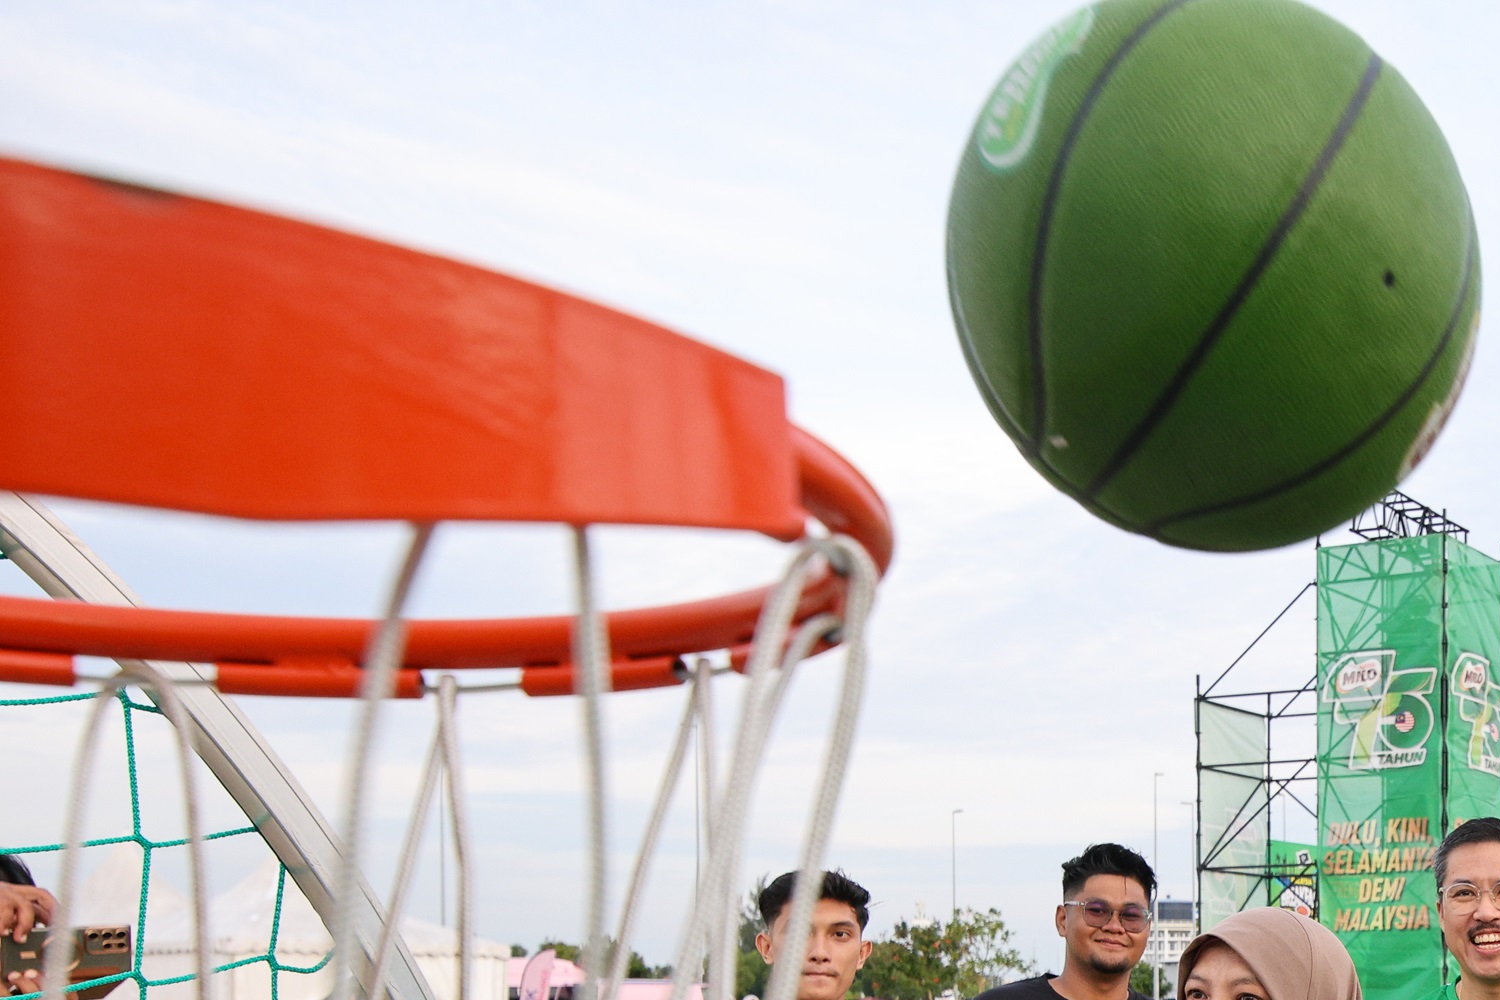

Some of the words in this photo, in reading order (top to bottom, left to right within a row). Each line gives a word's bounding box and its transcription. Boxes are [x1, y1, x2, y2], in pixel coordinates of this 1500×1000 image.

[1343, 669, 1377, 685] MILO
[1377, 751, 1424, 766] TAHUN
[1484, 758, 1500, 774] TAHU
[1327, 819, 1382, 850] DULU,
[1387, 817, 1434, 845] KINI,
[1322, 847, 1437, 876] SELAMANYA
[1358, 877, 1406, 904] DEMI
[1333, 905, 1430, 933] MALAYSIA
